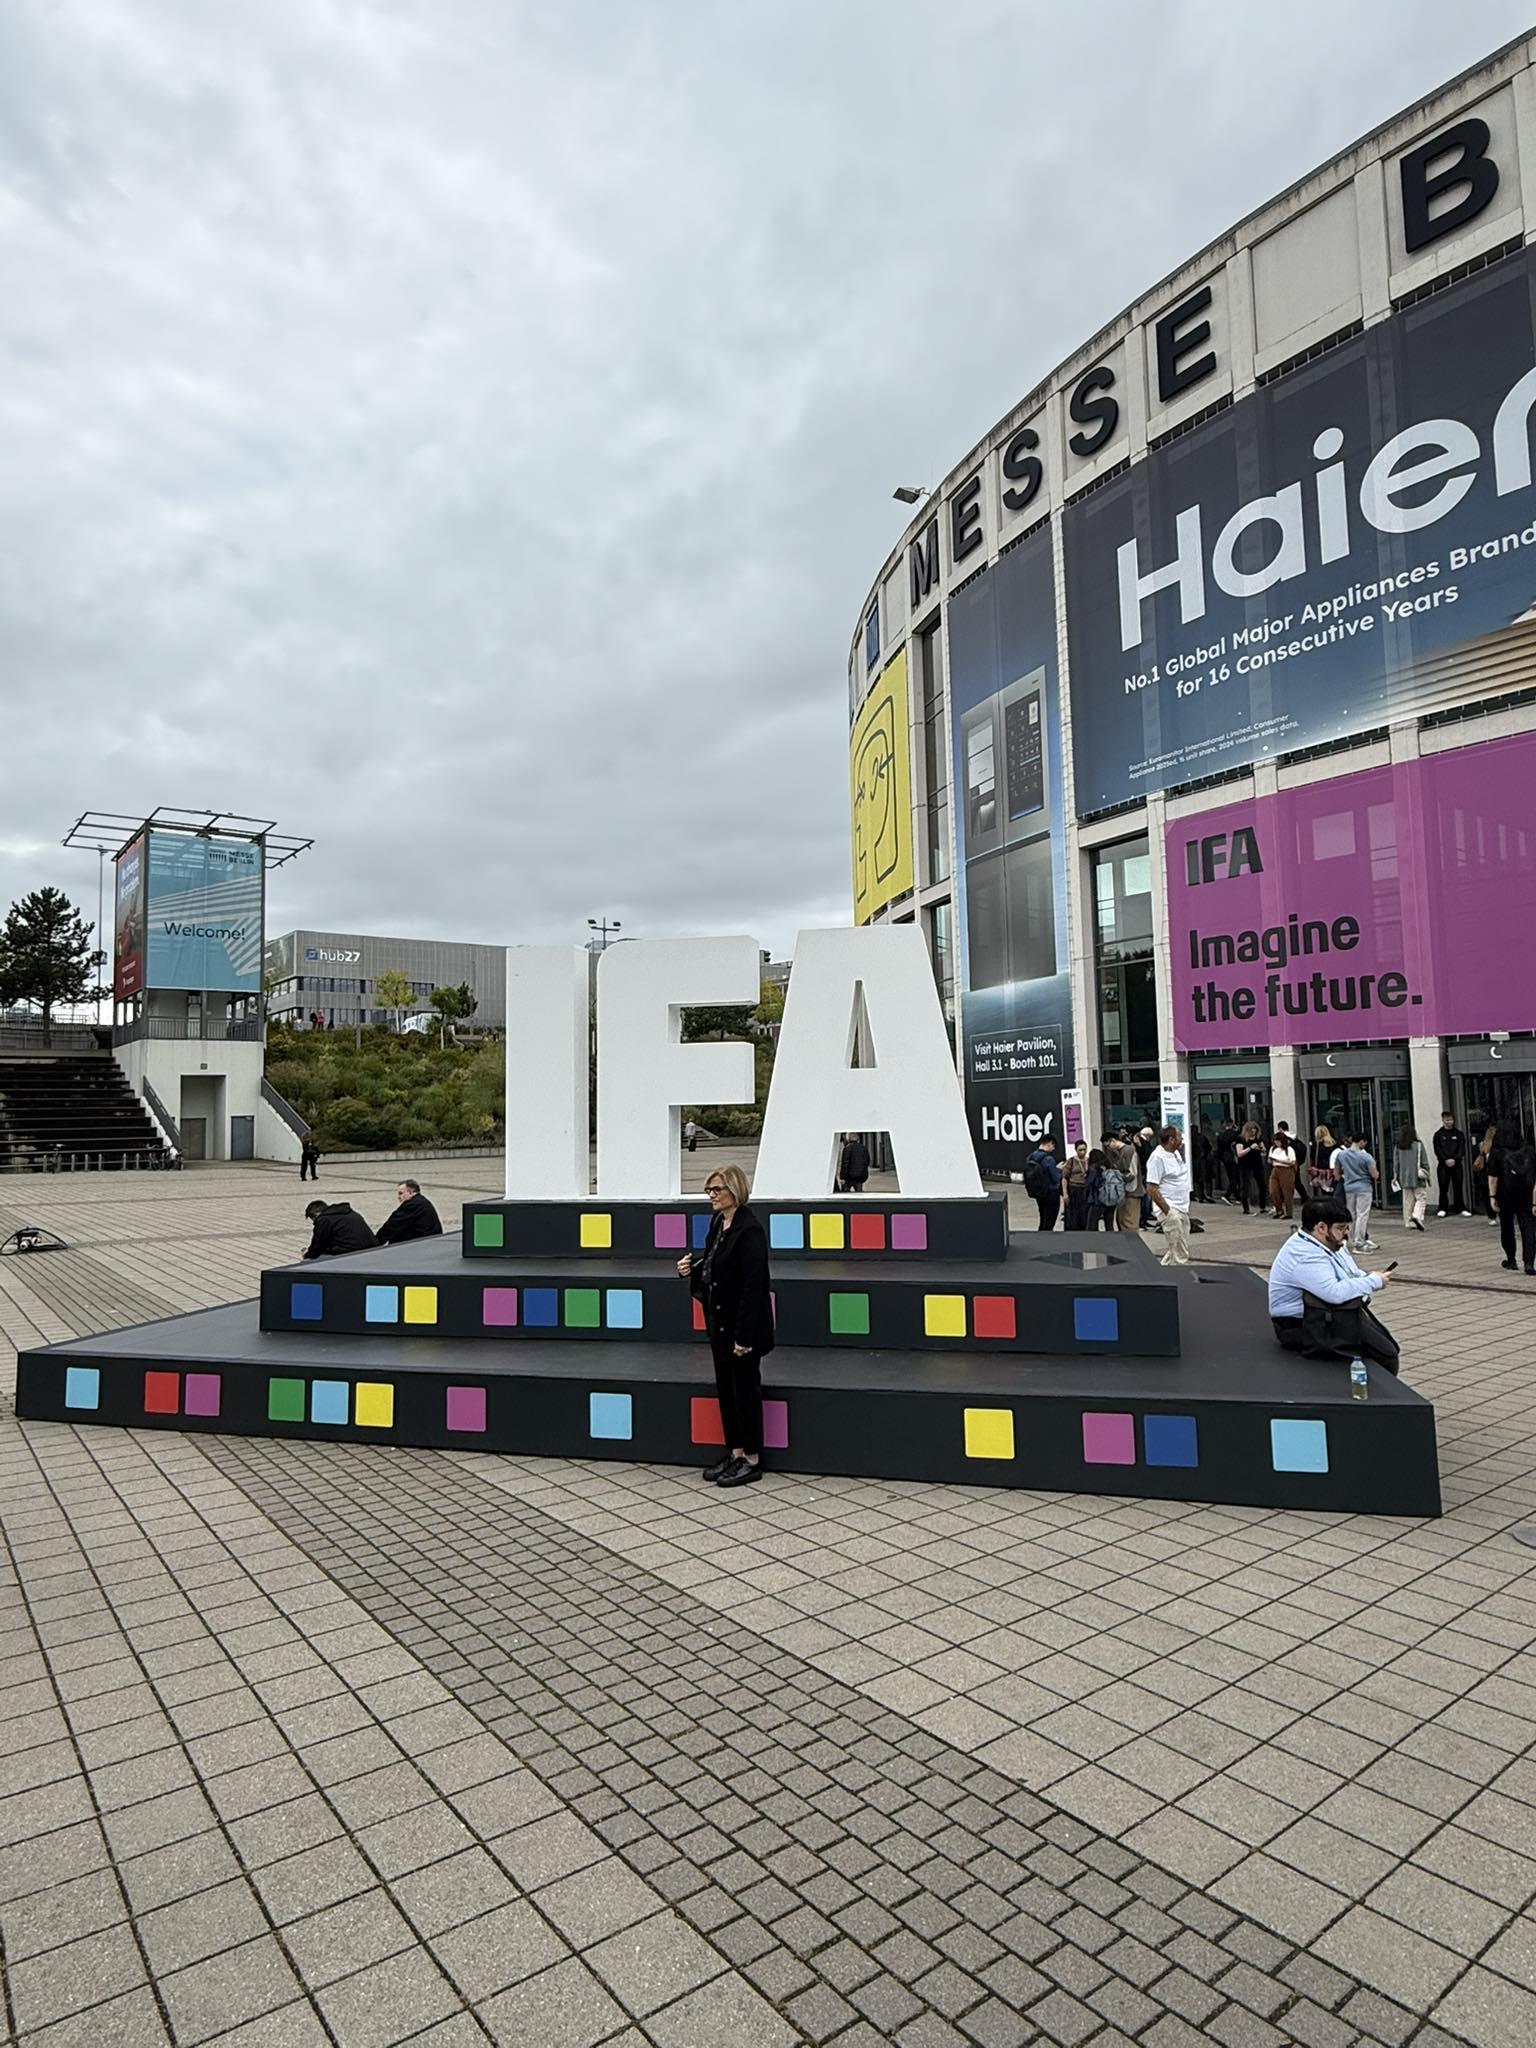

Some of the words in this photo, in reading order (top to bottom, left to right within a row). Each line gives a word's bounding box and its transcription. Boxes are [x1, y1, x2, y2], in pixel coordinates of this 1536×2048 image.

[909, 285, 1217, 605] MESSE
[1117, 367, 1536, 652] Haier
[1124, 666, 1161, 694] No.1
[1166, 637, 1226, 676] Global
[1232, 613, 1294, 651] Major
[1300, 560, 1440, 626] Appliances
[1175, 679, 1202, 698] for
[1209, 663, 1230, 687] 16
[1236, 615, 1374, 674] Consecutive
[1382, 583, 1459, 623] Years
[1185, 734, 1225, 752] International
[1254, 715, 1289, 730] Consumer
[229, 857, 254, 865] BELIN
[1186, 827, 1264, 886] IFA
[164, 921, 246, 941] Welcome!
[320, 949, 360, 962] hub27
[1189, 913, 1360, 970] Imagine
[1192, 981, 1255, 1022] the
[1265, 972, 1422, 1016] future.
[505, 924, 985, 1199] IFA
[975, 1042, 991, 1055] Visit
[993, 1040, 1015, 1054] Haier
[1017, 1037, 1056, 1051] Pavilion,
[975, 1060, 990, 1072] Hall
[992, 1059, 1002, 1071] 3.1
[1010, 1056, 1036, 1069] Booth
[1038, 1055, 1058, 1067] 101.
[982, 1104, 1053, 1142] Haier
